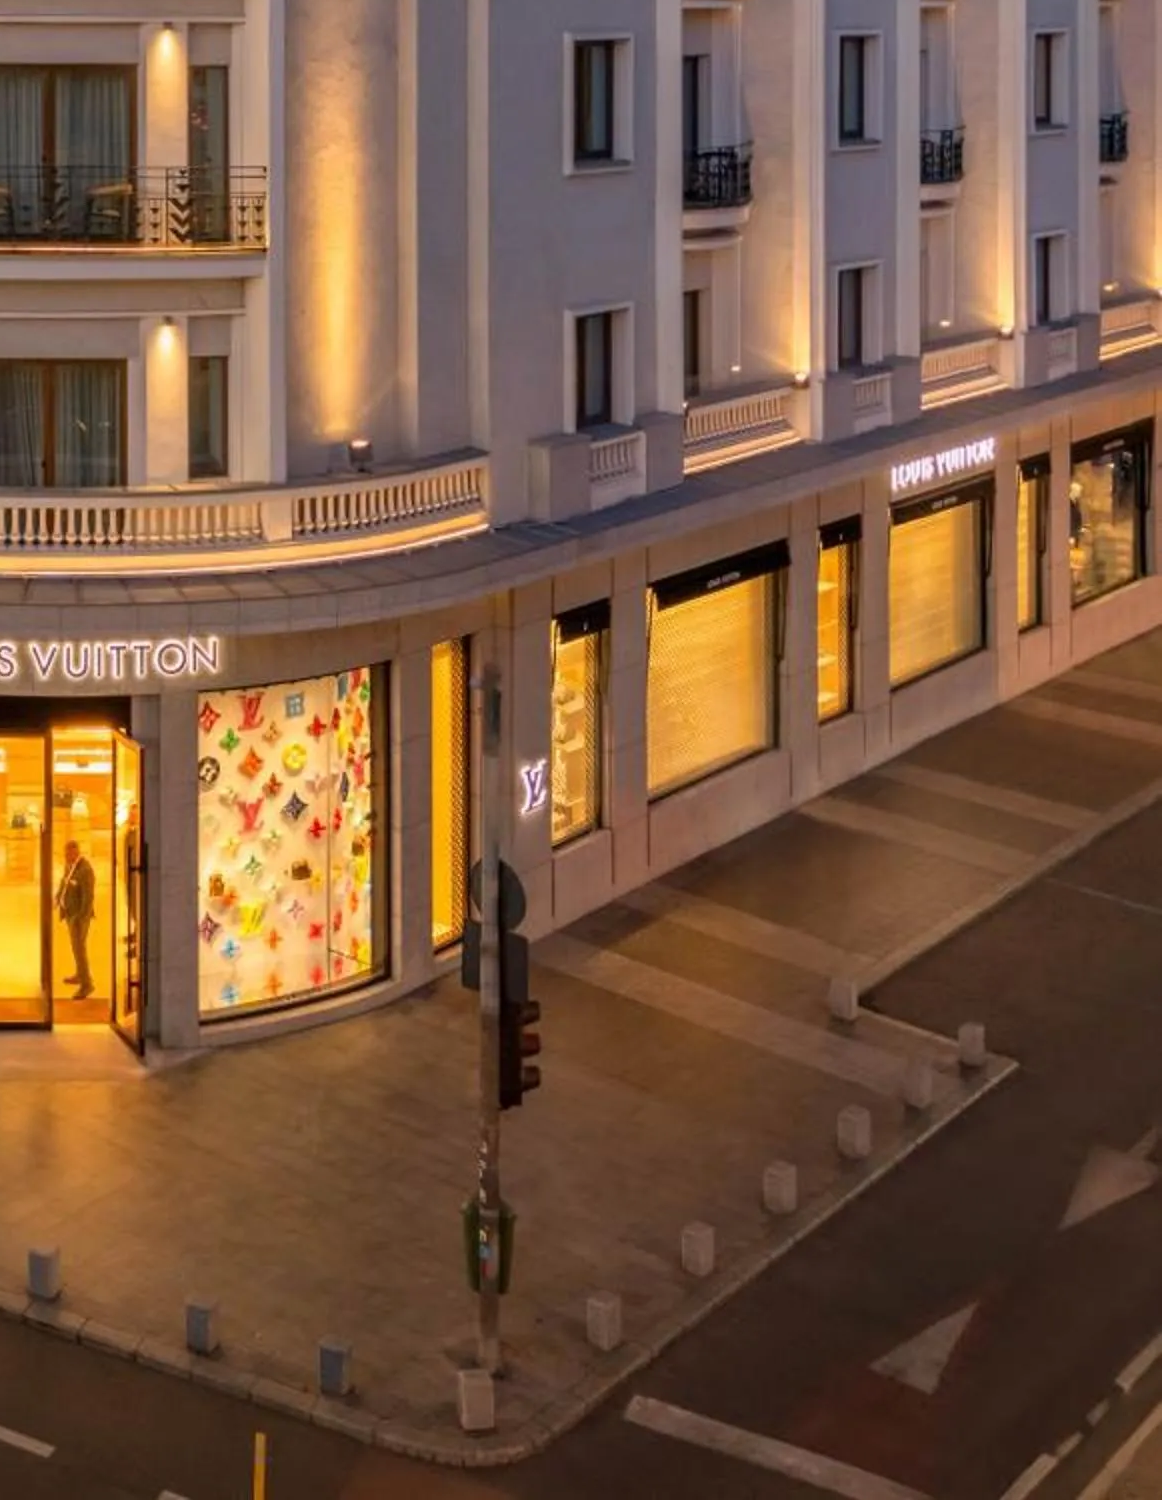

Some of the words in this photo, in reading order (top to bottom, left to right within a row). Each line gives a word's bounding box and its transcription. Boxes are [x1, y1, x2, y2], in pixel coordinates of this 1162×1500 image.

[891, 455, 935, 492] LOUIS
[936, 437, 995, 476] VUITTON
[29, 635, 221, 679] VUITTON
